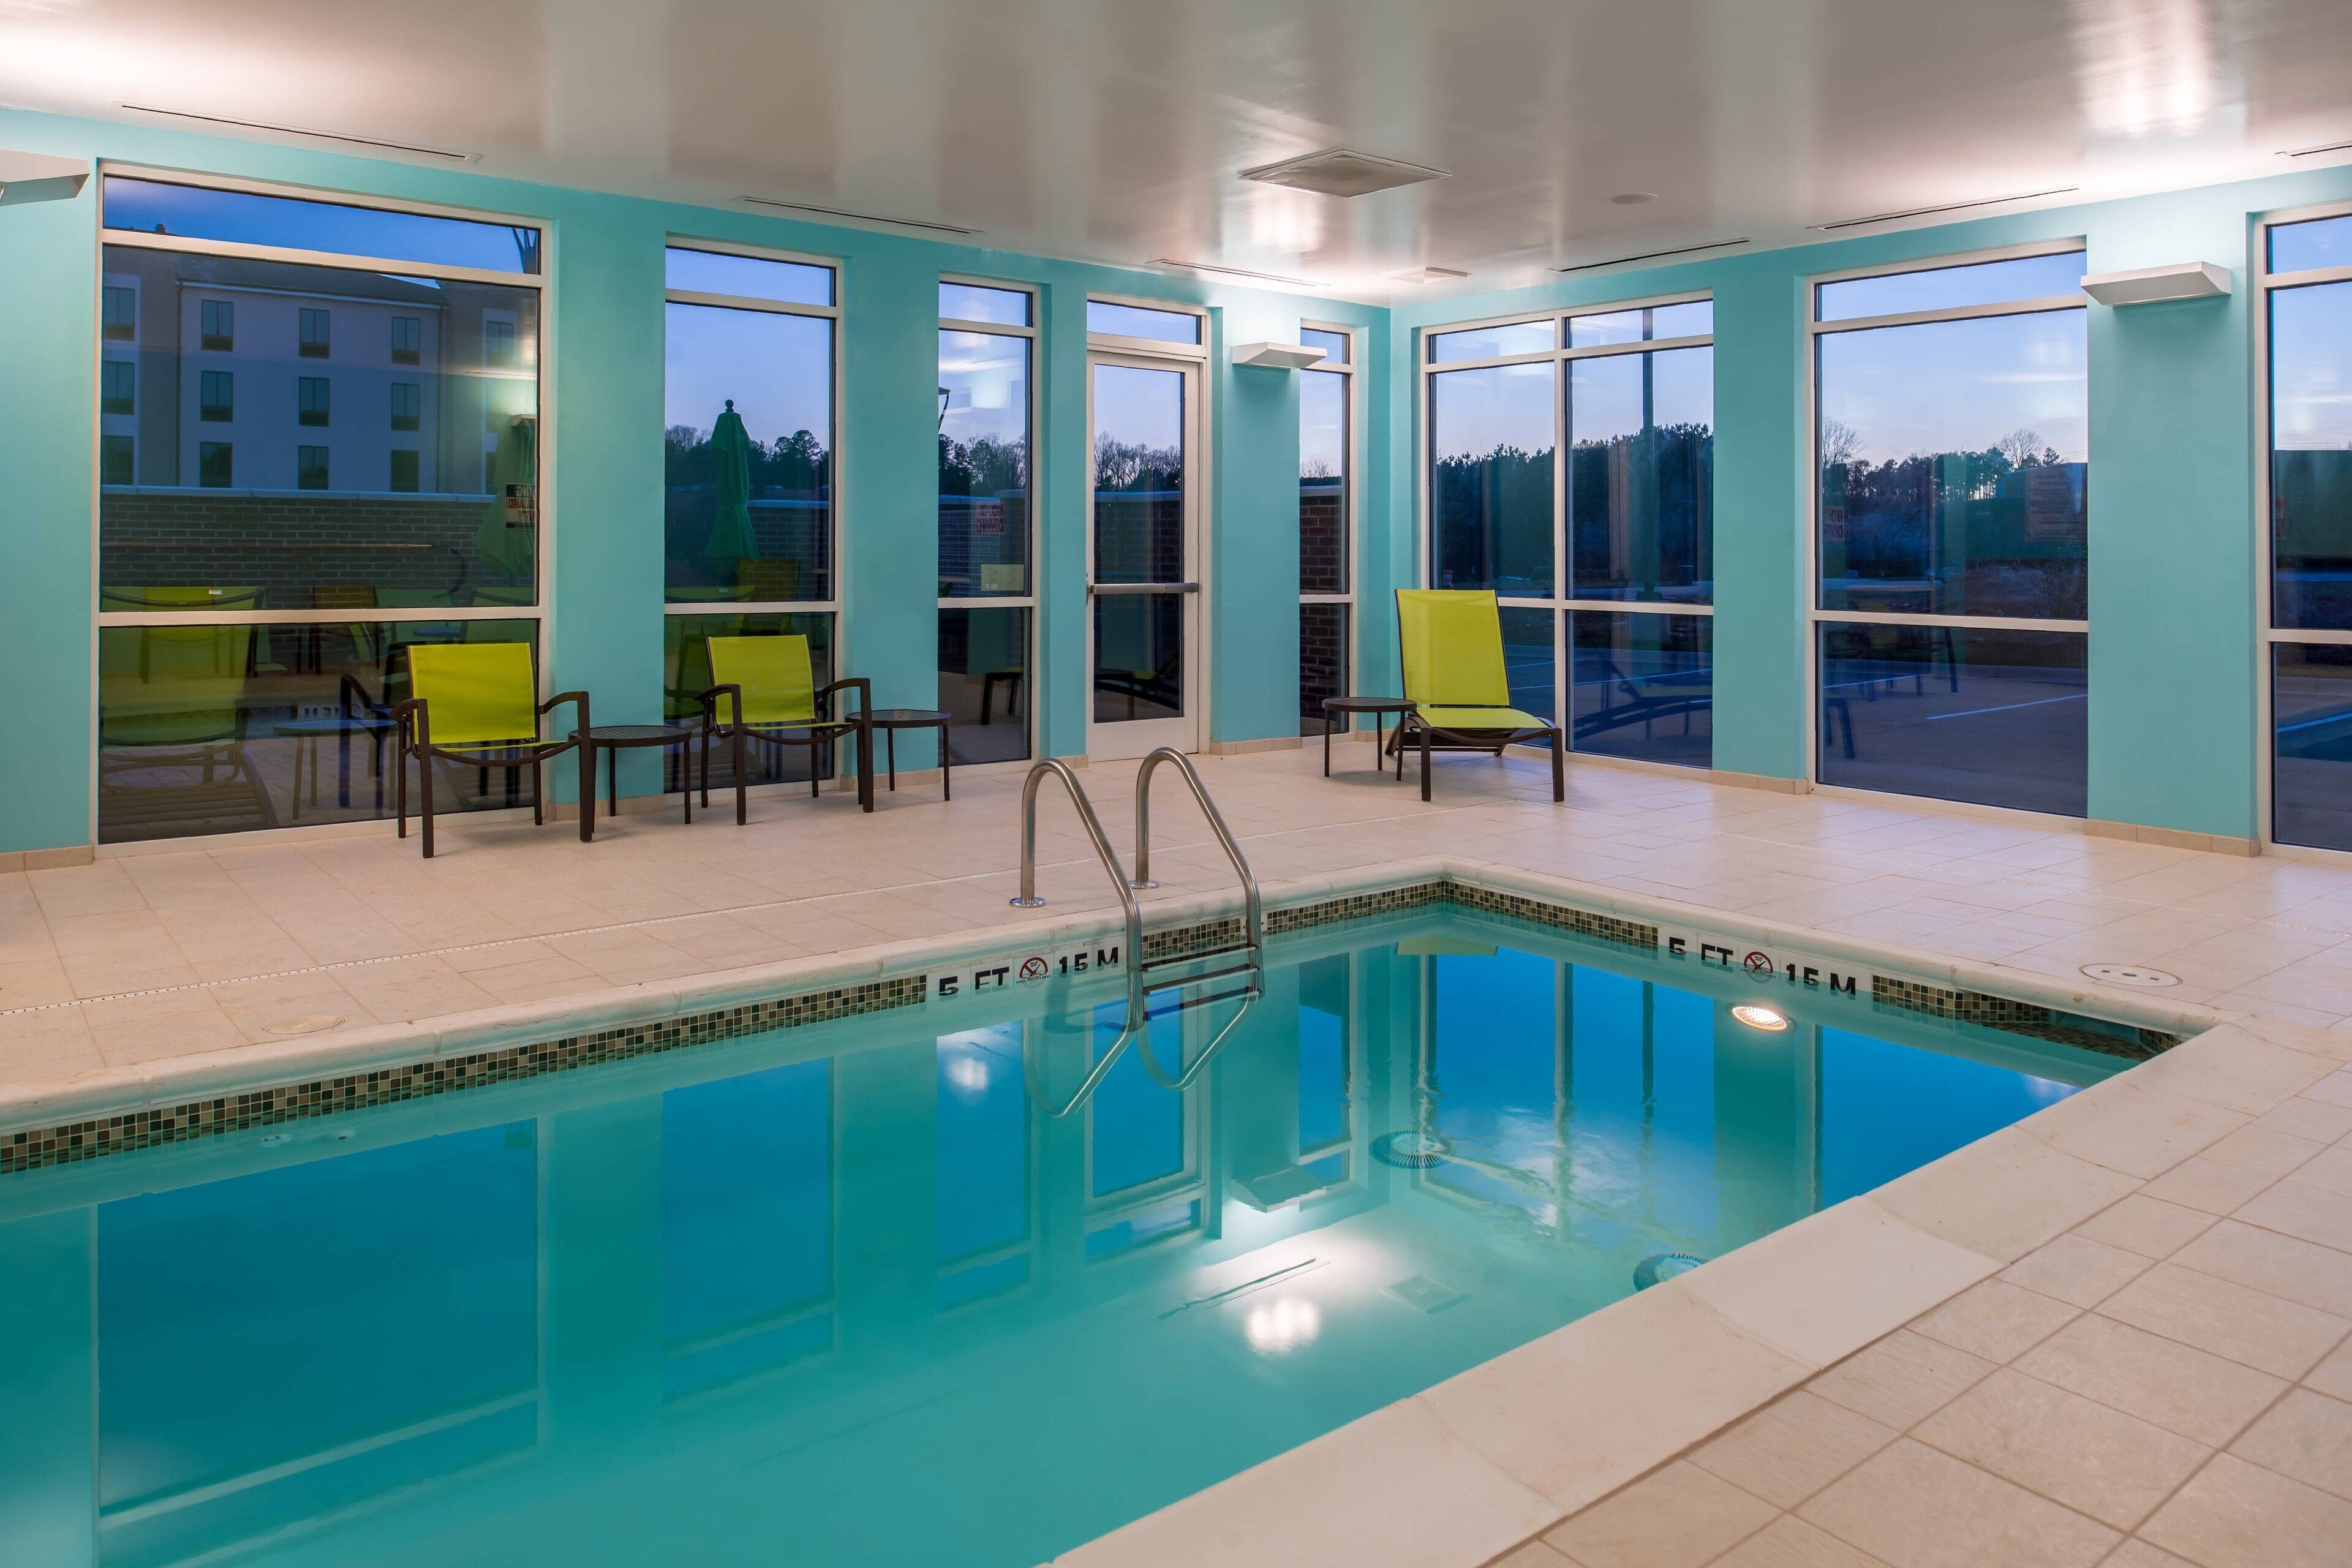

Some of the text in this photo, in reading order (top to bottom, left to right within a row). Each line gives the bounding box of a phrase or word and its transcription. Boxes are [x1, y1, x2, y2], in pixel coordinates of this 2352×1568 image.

[938, 976, 959, 996] 5
[975, 967, 1010, 990] FT
[1098, 947, 1119, 967] M
[1669, 937, 1686, 956] 5
[1701, 943, 1734, 965] FT
[1830, 973, 1856, 995] M
